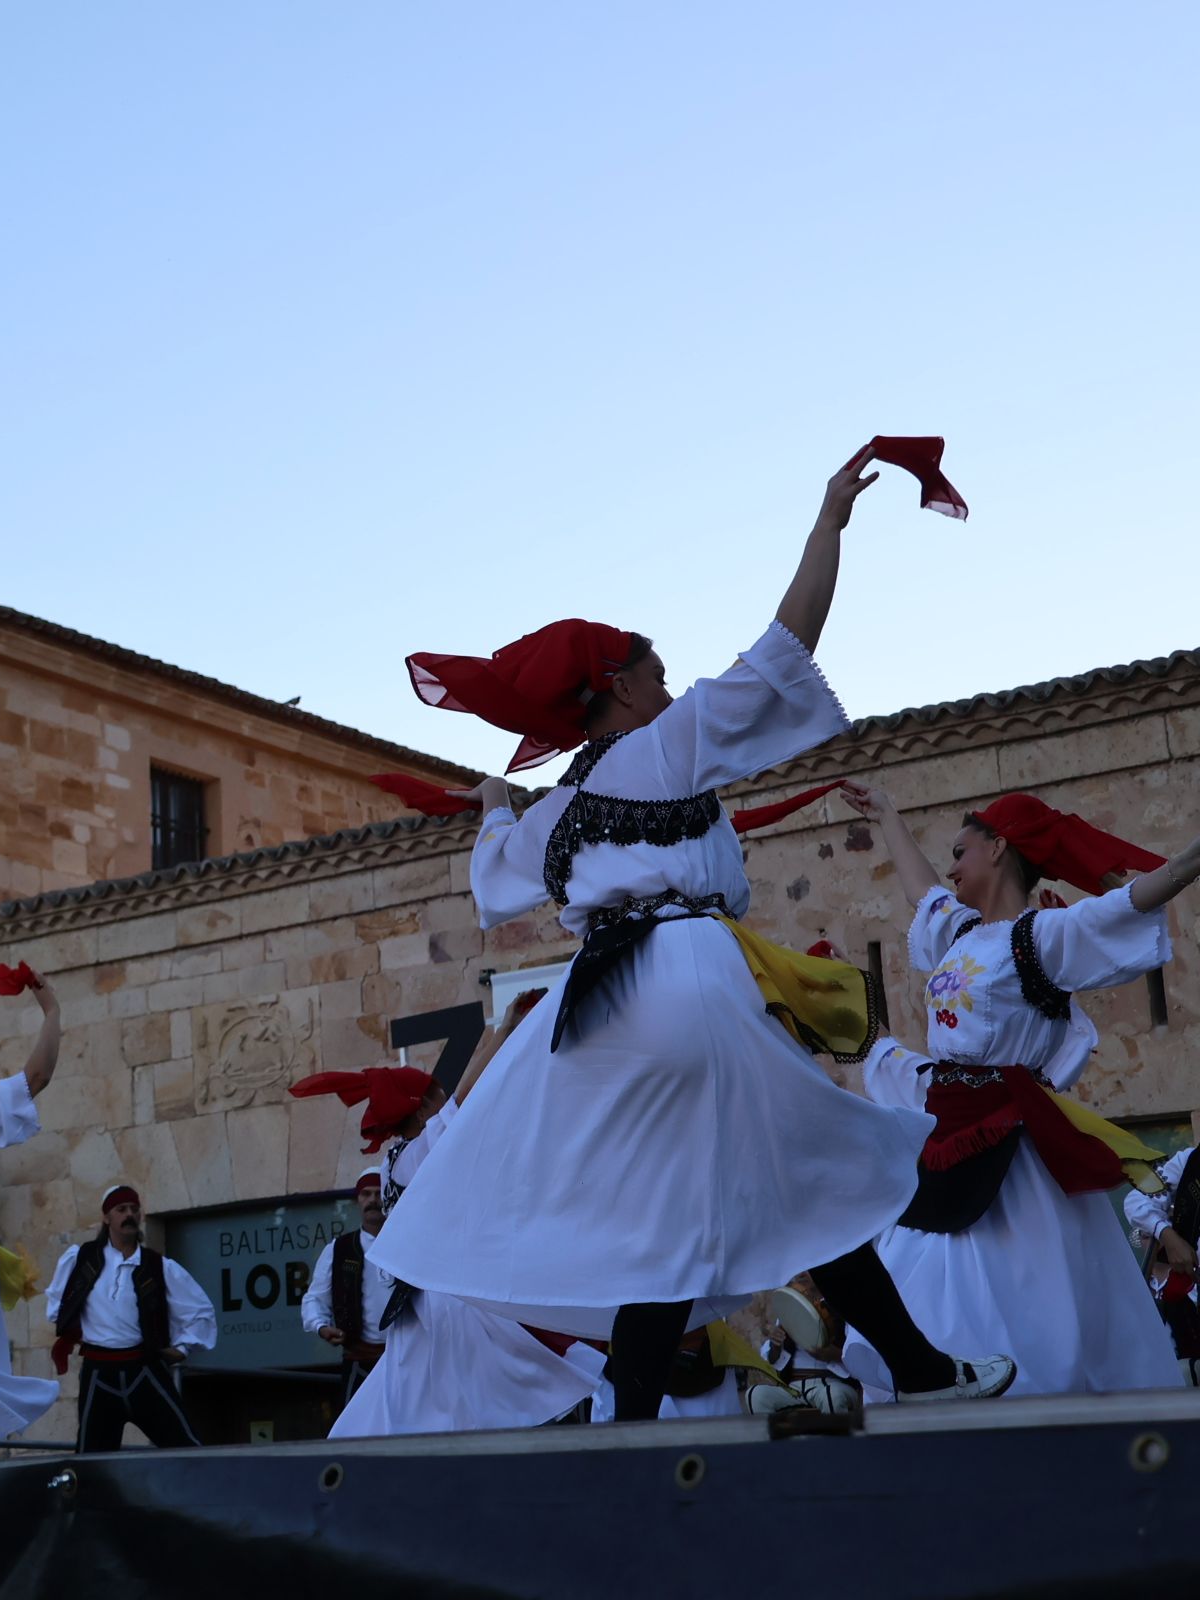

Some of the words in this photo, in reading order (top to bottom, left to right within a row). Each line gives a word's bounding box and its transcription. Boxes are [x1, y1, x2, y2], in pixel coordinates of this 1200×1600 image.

[220, 1221, 345, 1257] BALTASAR
[221, 1261, 312, 1312] LOB
[223, 1320, 272, 1335] CASTILLO
